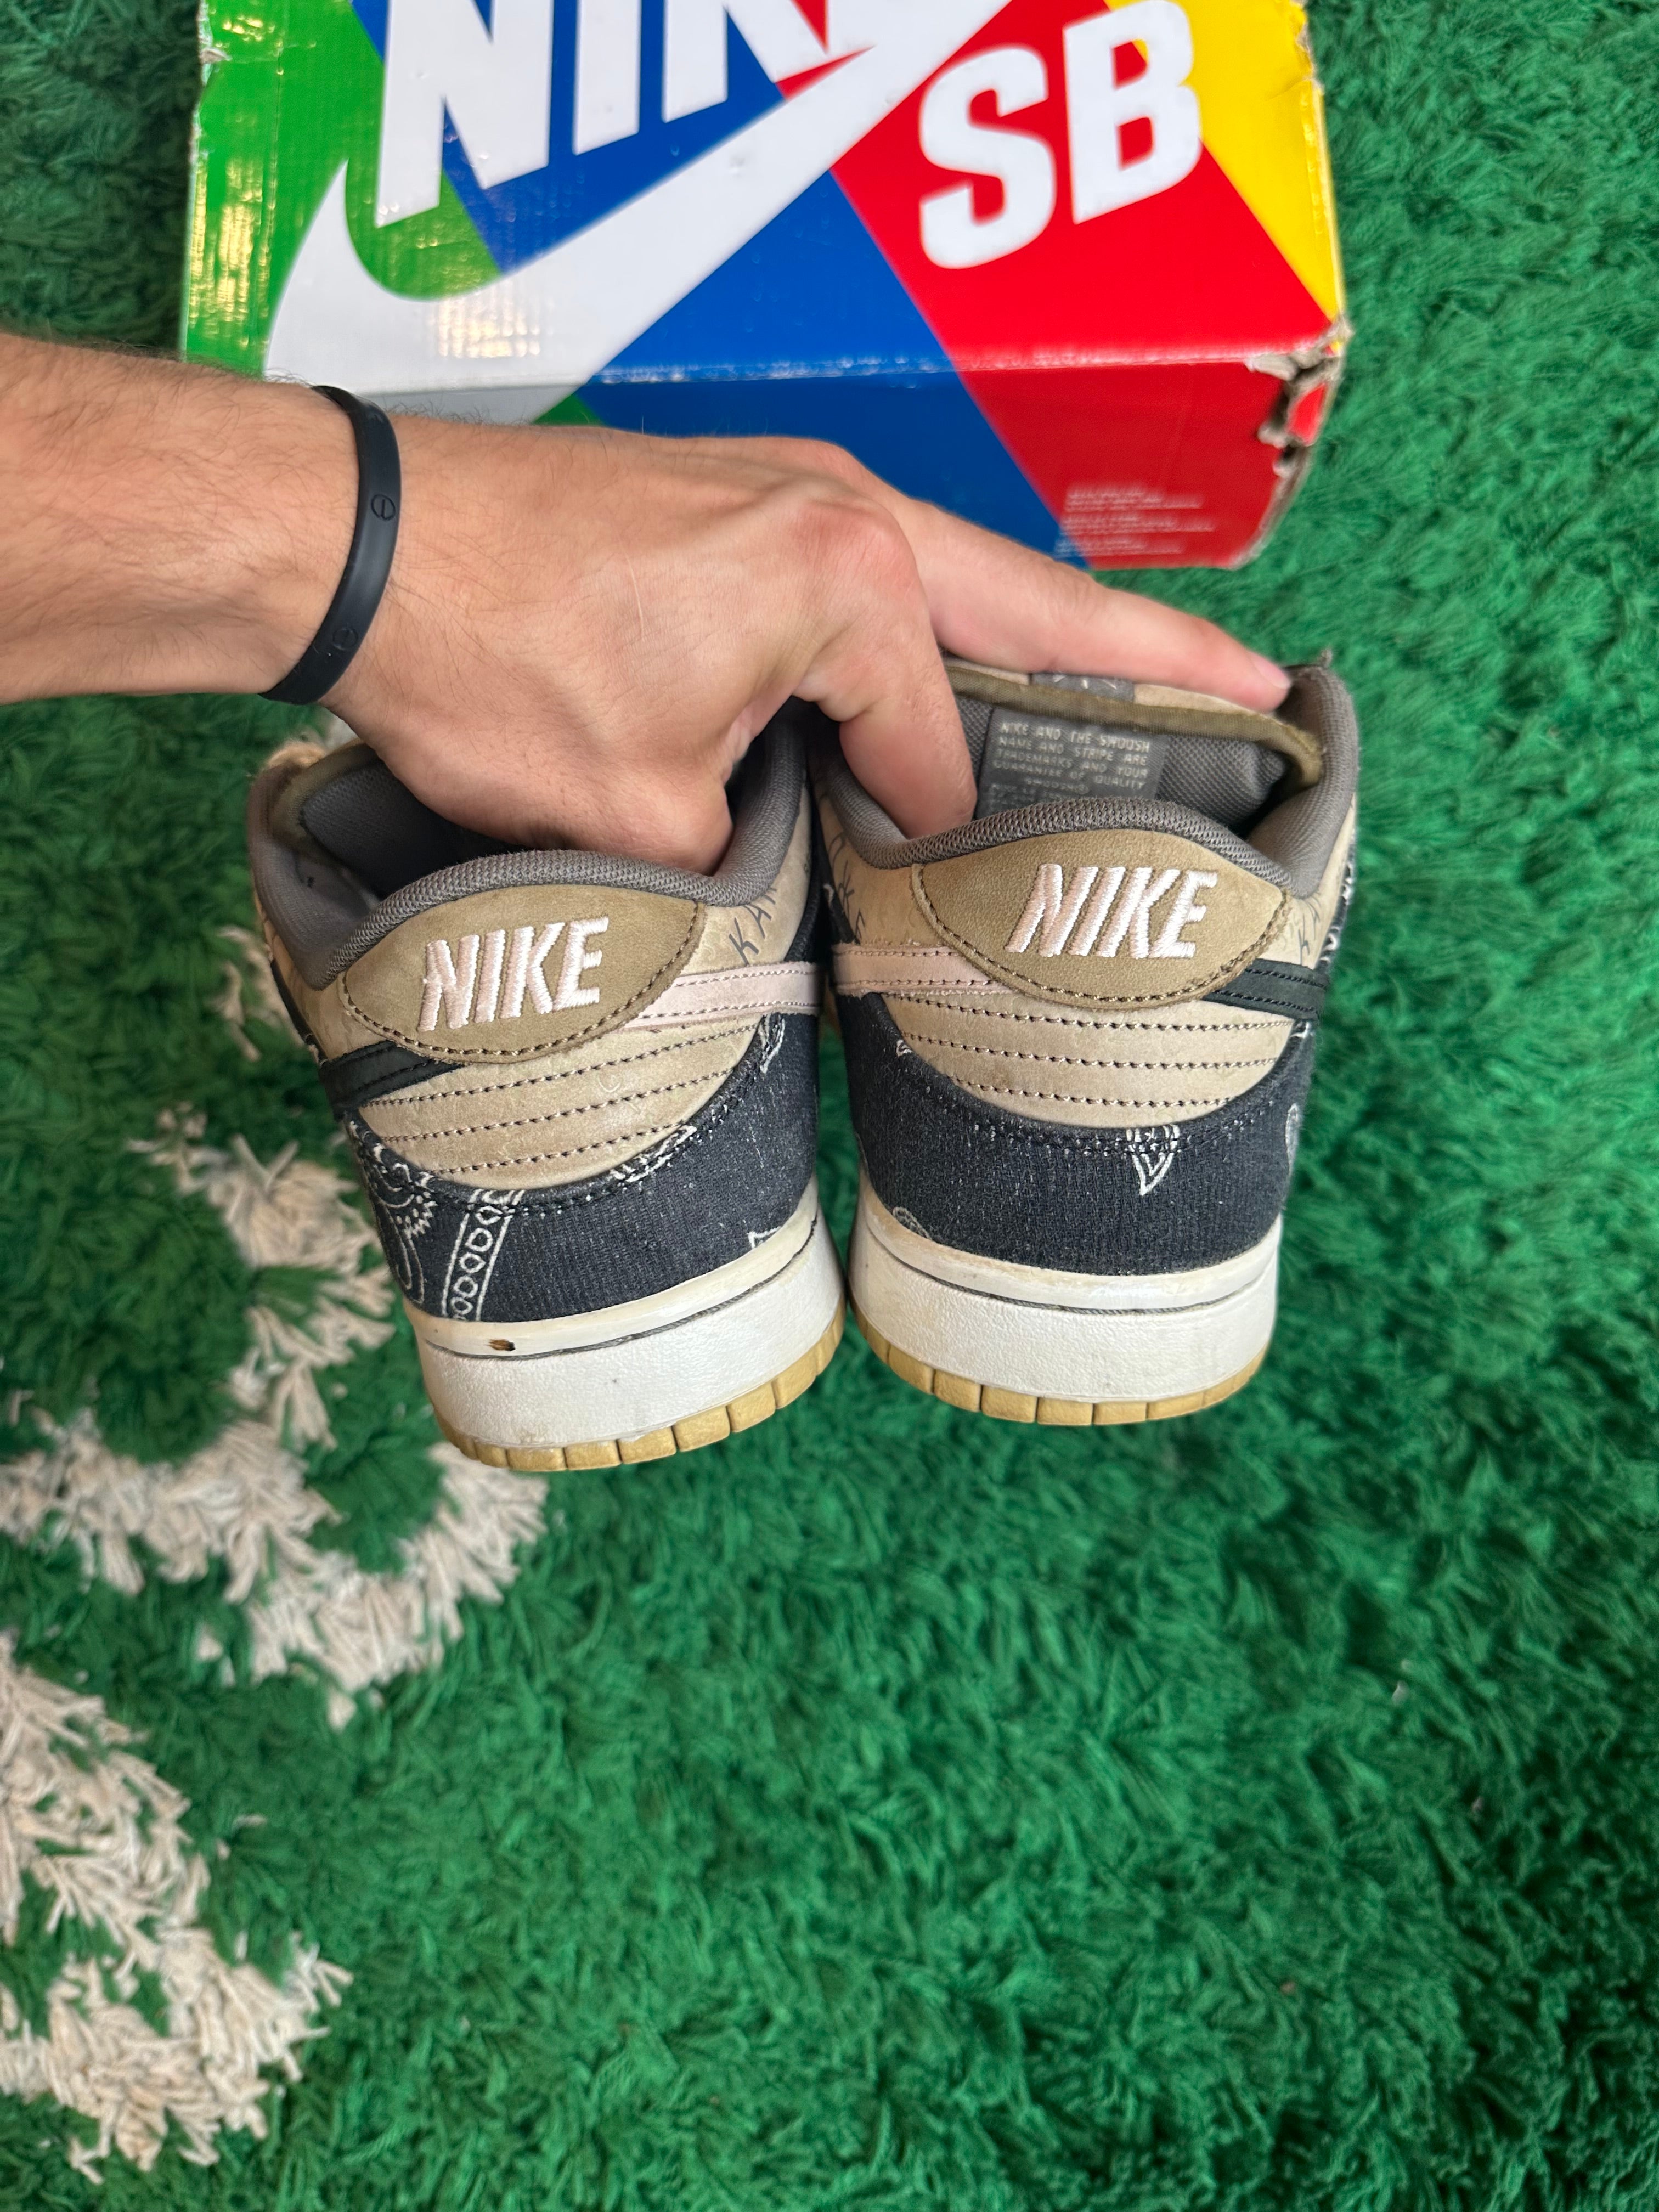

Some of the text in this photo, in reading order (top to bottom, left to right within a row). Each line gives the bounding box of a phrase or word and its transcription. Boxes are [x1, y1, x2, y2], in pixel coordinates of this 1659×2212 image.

[918, 0, 1203, 270] SB
[998, 737, 1148, 766] NAME AND STRIPE ARE
[1000, 721, 1150, 753] NIKE AND THE SWOOSH
[992, 760, 1063, 777] GUARANTEE
[1094, 774, 1147, 790] QUALITY
[997, 749, 1149, 778] TRADEMARKS AND YOUR
[1004, 862, 1217, 959] NIKE
[418, 916, 609, 1032] NIKE
